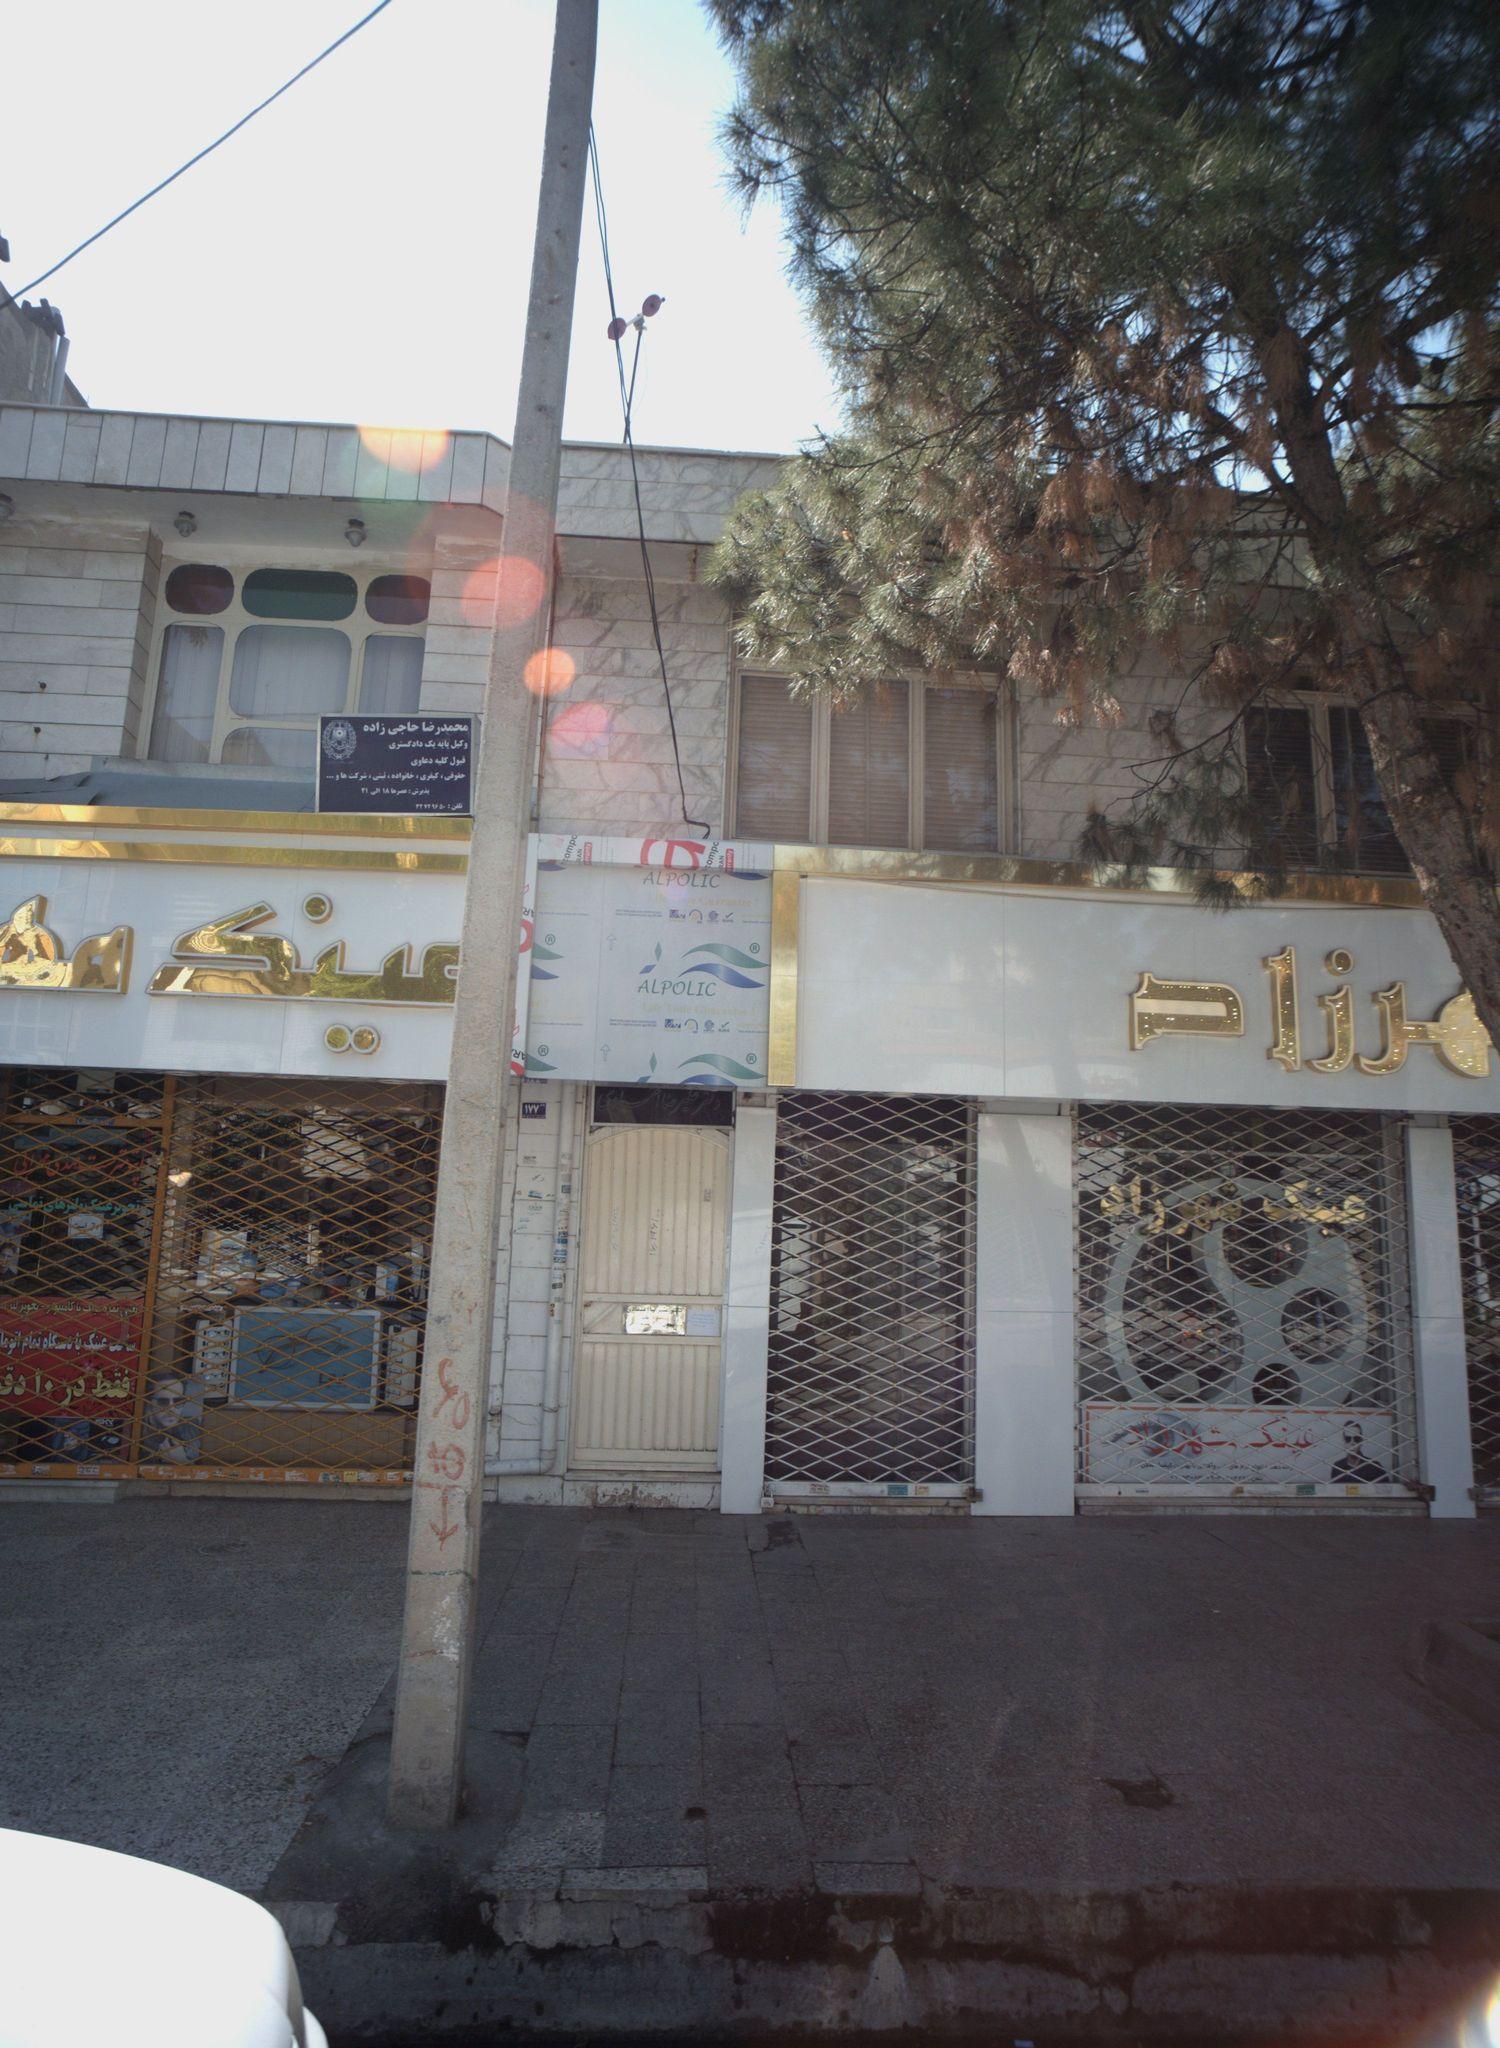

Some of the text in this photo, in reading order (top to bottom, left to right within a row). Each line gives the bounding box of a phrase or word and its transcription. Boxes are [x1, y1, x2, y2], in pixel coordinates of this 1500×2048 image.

[363, 721, 469, 736] محمدرضا حاجی زاده
[388, 739, 468, 750] وکیل پایه یک دادگستری
[410, 755, 466, 767] قبول کلیه دعاوی
[642, 871, 721, 889] ALPOLIC
[637, 980, 717, 997] ALPOLIC
[59, 1376, 86, 1408] در
[91, 1369, 130, 1399] فقط
